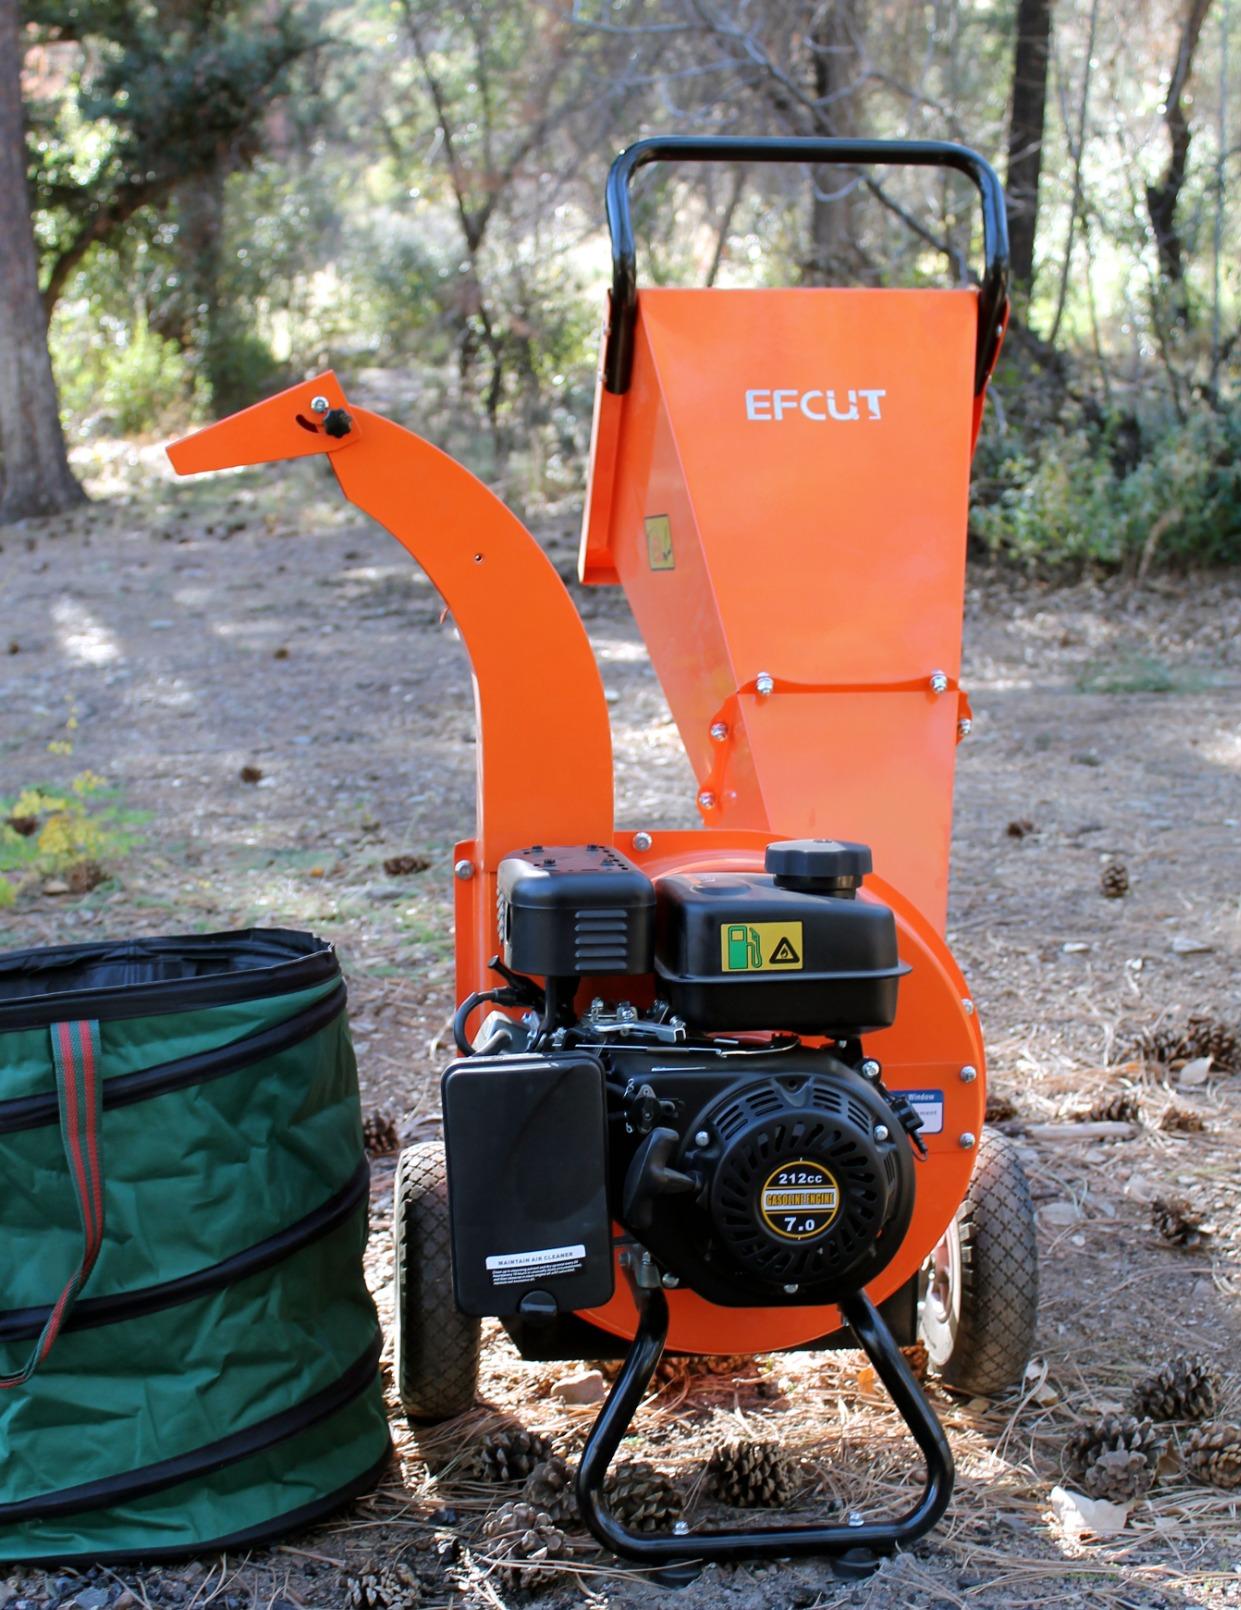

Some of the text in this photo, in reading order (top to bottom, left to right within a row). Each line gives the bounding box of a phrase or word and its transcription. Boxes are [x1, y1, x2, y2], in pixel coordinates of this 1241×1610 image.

[745, 389, 886, 421] EFCUT
[908, 1093, 934, 1101] Window
[779, 1173, 823, 1184] 212cc
[767, 1192, 833, 1206] GASOLINE ENGINE
[784, 1216, 815, 1232] 7.0
[498, 1257, 530, 1266] MAINTAIN
[544, 1252, 573, 1260] CLEANER
